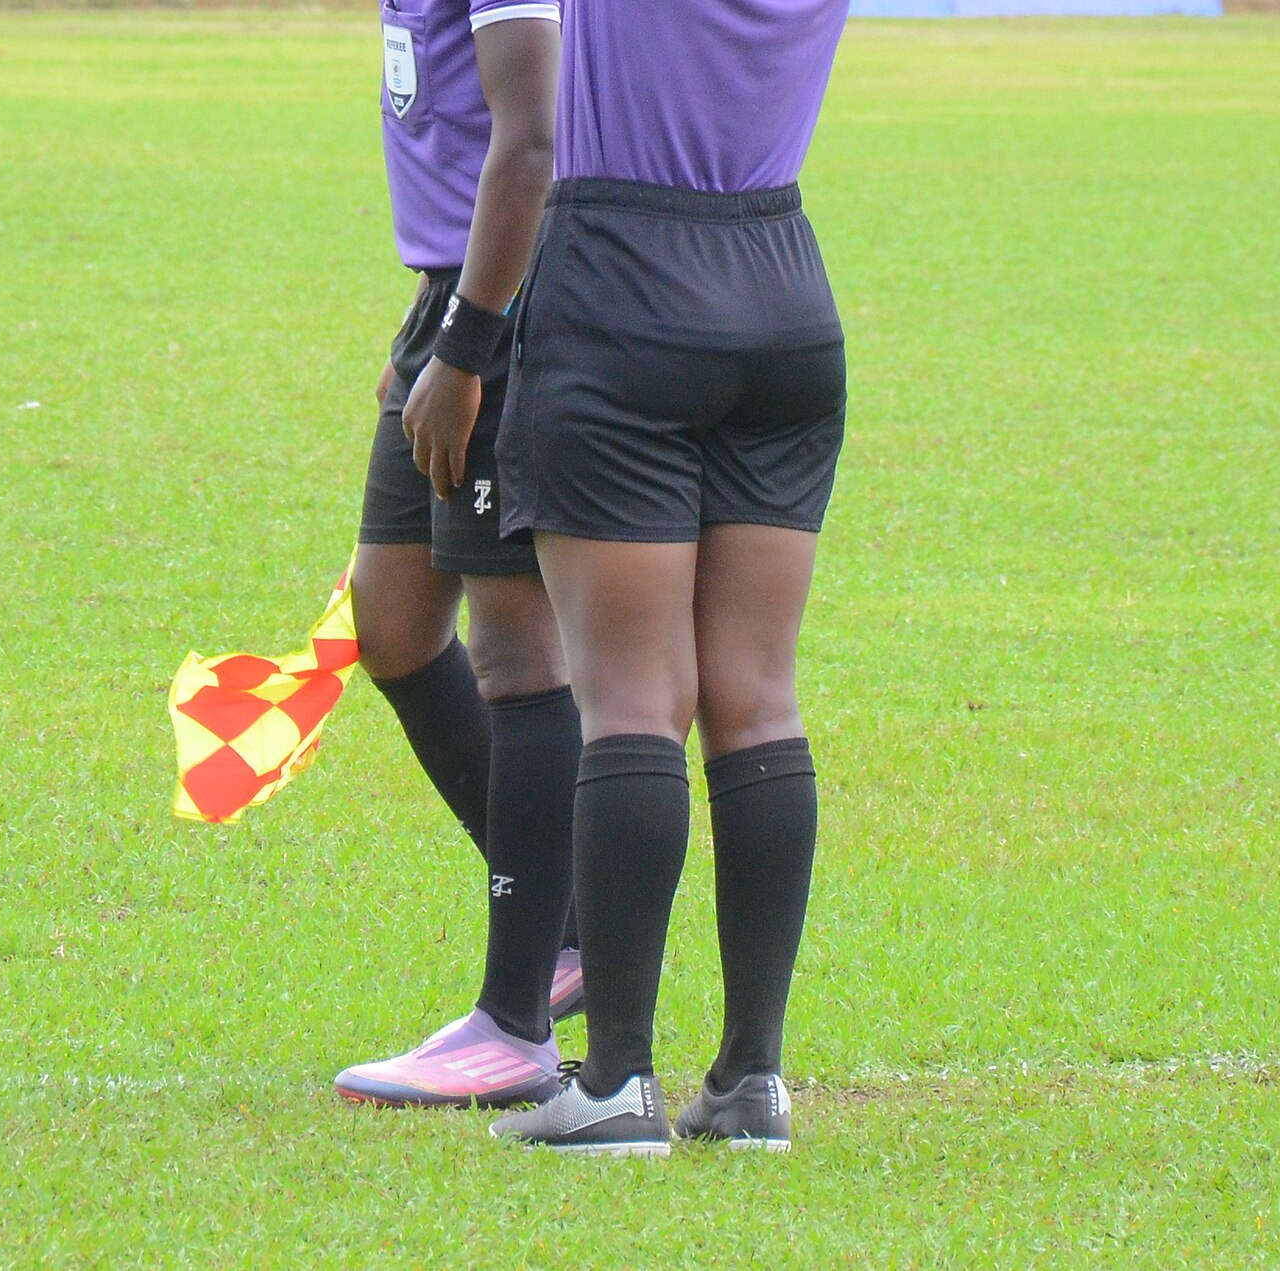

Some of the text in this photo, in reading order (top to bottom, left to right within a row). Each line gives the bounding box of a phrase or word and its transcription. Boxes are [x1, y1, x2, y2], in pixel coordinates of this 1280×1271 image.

[386, 38, 407, 53] REFEREE
[643, 1081, 655, 1118] KIPSTA
[767, 1080, 778, 1117] KIPSTA
